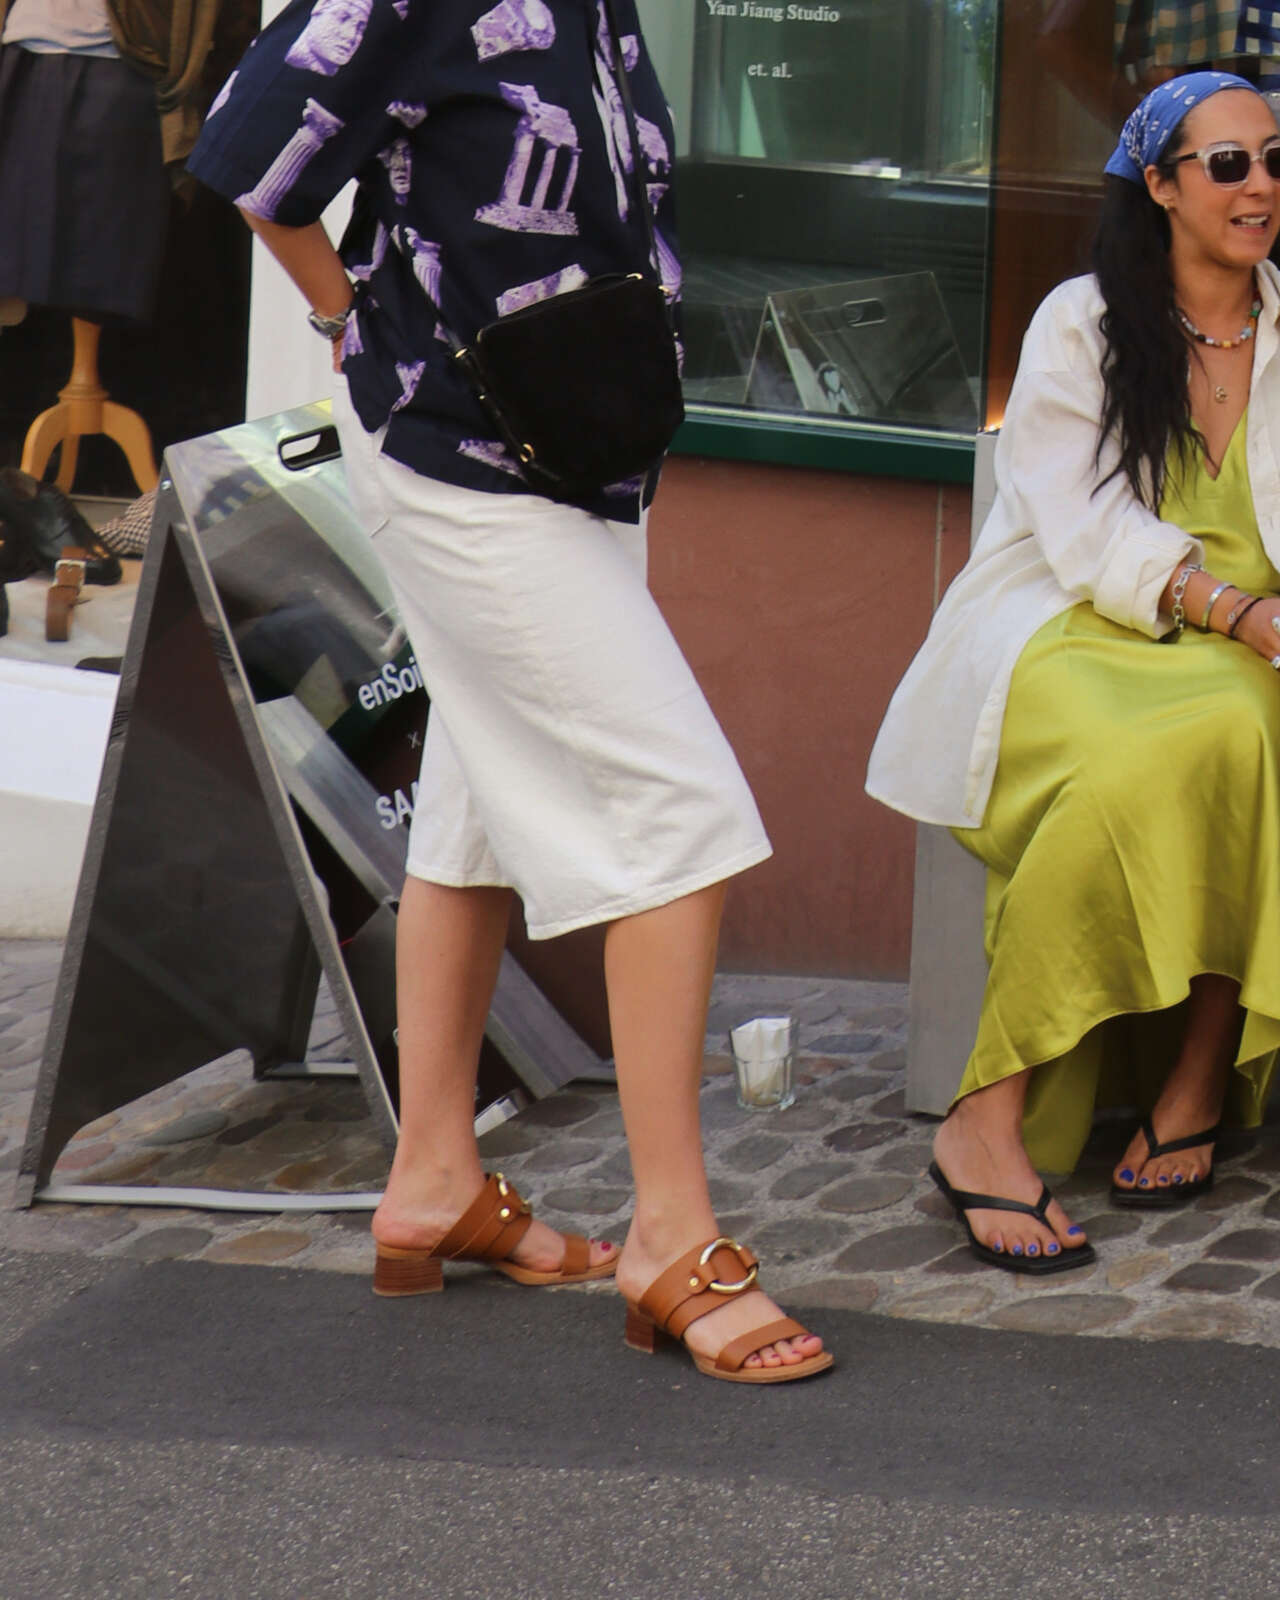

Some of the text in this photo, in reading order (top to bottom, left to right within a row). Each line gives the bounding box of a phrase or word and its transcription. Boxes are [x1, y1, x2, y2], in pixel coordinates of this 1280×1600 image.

[706, 0, 840, 23] Yan Jiang Studio
[747, 62, 793, 78] et. al.
